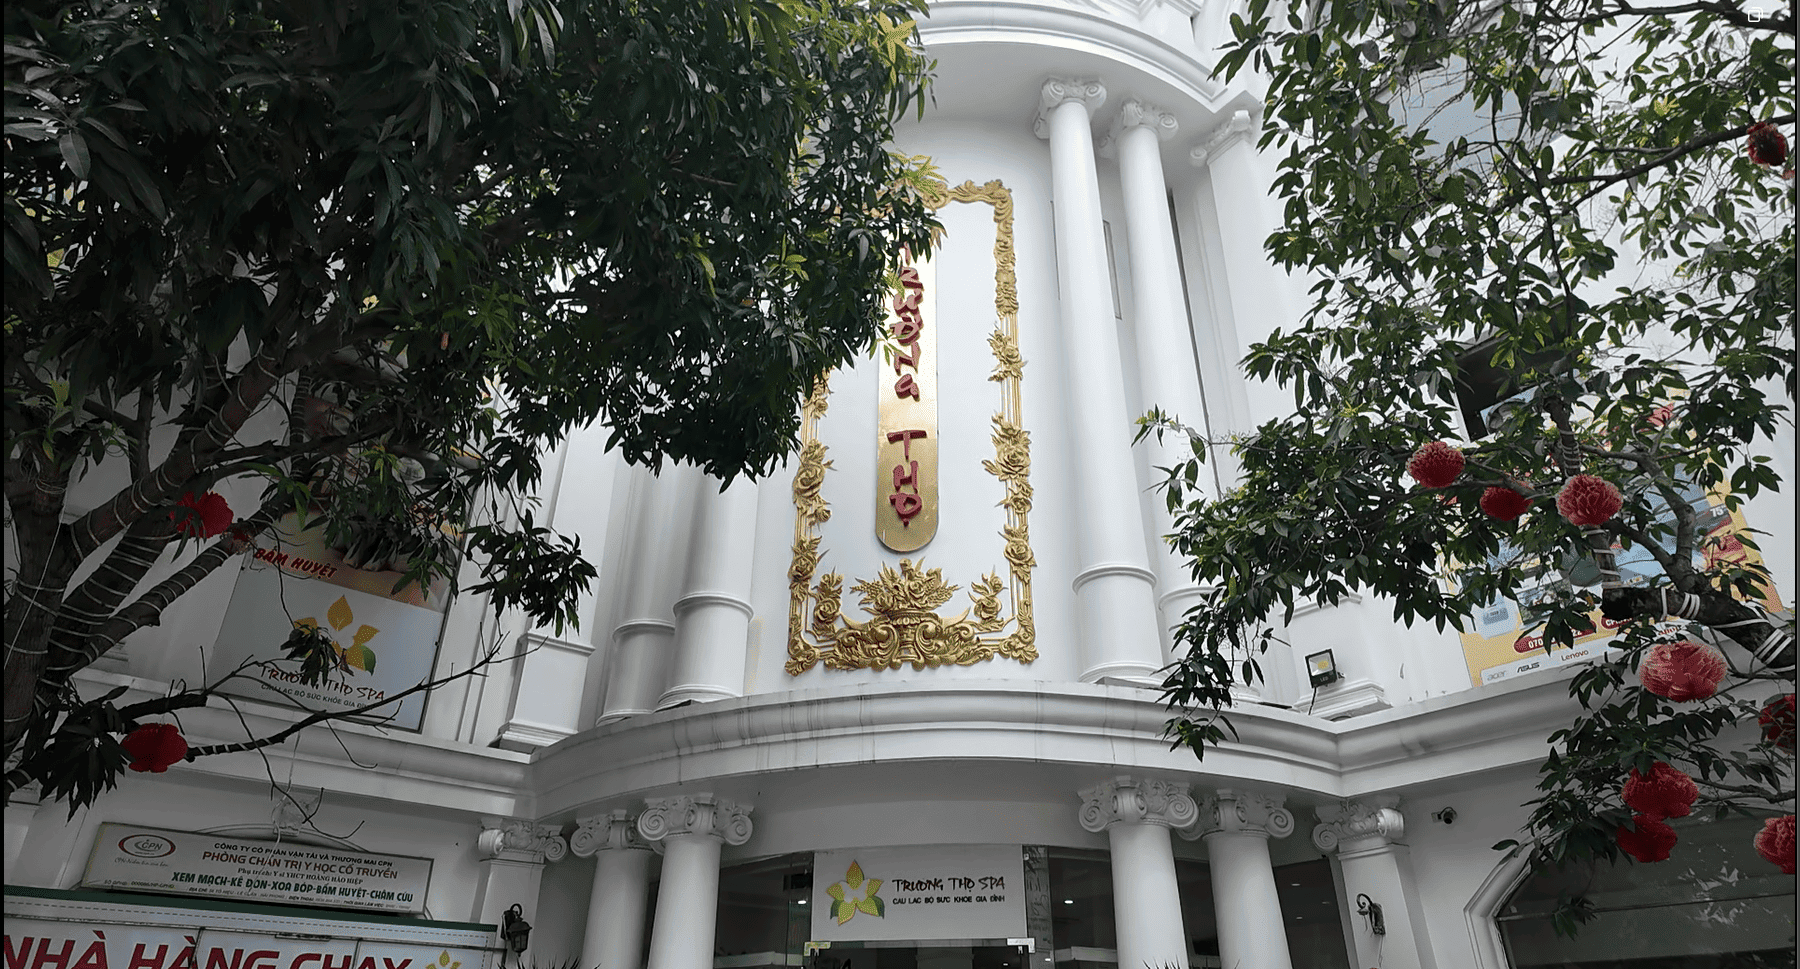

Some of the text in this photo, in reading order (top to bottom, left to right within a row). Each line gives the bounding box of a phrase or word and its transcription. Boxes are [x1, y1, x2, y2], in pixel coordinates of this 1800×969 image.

[887, 429, 927, 527] THỌ
[290, 557, 338, 579] HUYỆT
[1517, 662, 1540, 673] ASUS
[1561, 649, 1589, 661] Lenovo
[357, 687, 385, 702] SPA
[202, 850, 247, 865] PHÒNG
[284, 859, 302, 872] TRỊ
[304, 861, 312, 871] Y
[313, 862, 336, 875] HỌC
[378, 860, 393, 868] CPN
[172, 872, 195, 883] XEM
[947, 877, 975, 893] THỌ
[978, 876, 1005, 891] SPA
[4, 930, 109, 969] NHÀ
